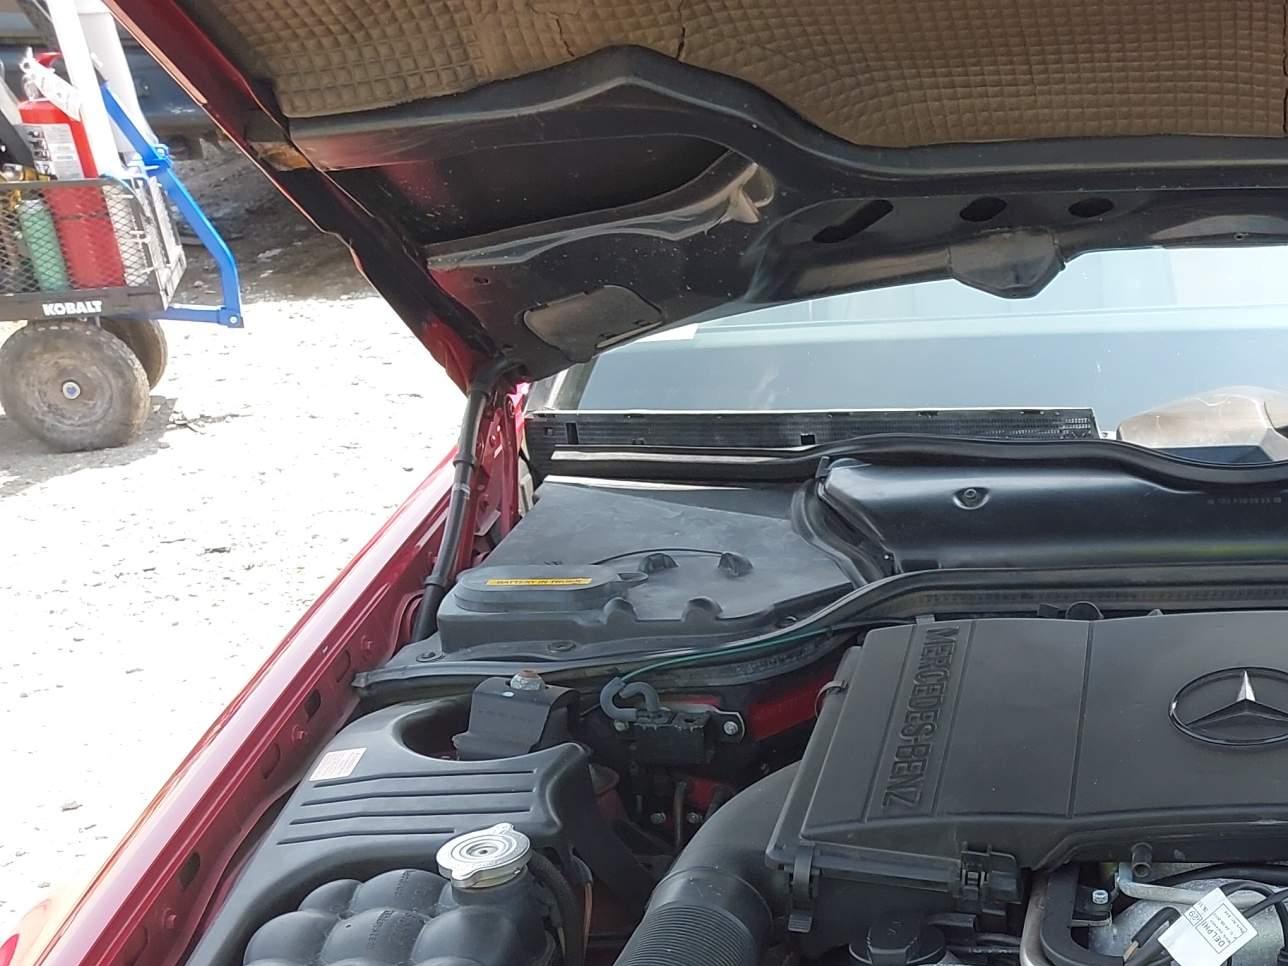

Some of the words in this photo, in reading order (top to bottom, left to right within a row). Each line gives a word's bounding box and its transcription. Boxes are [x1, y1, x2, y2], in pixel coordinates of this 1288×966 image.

[42, 300, 102, 316] KOBALT
[882, 626, 960, 809] MERCEDES-BENZ
[1201, 921, 1225, 947] DELPHI
